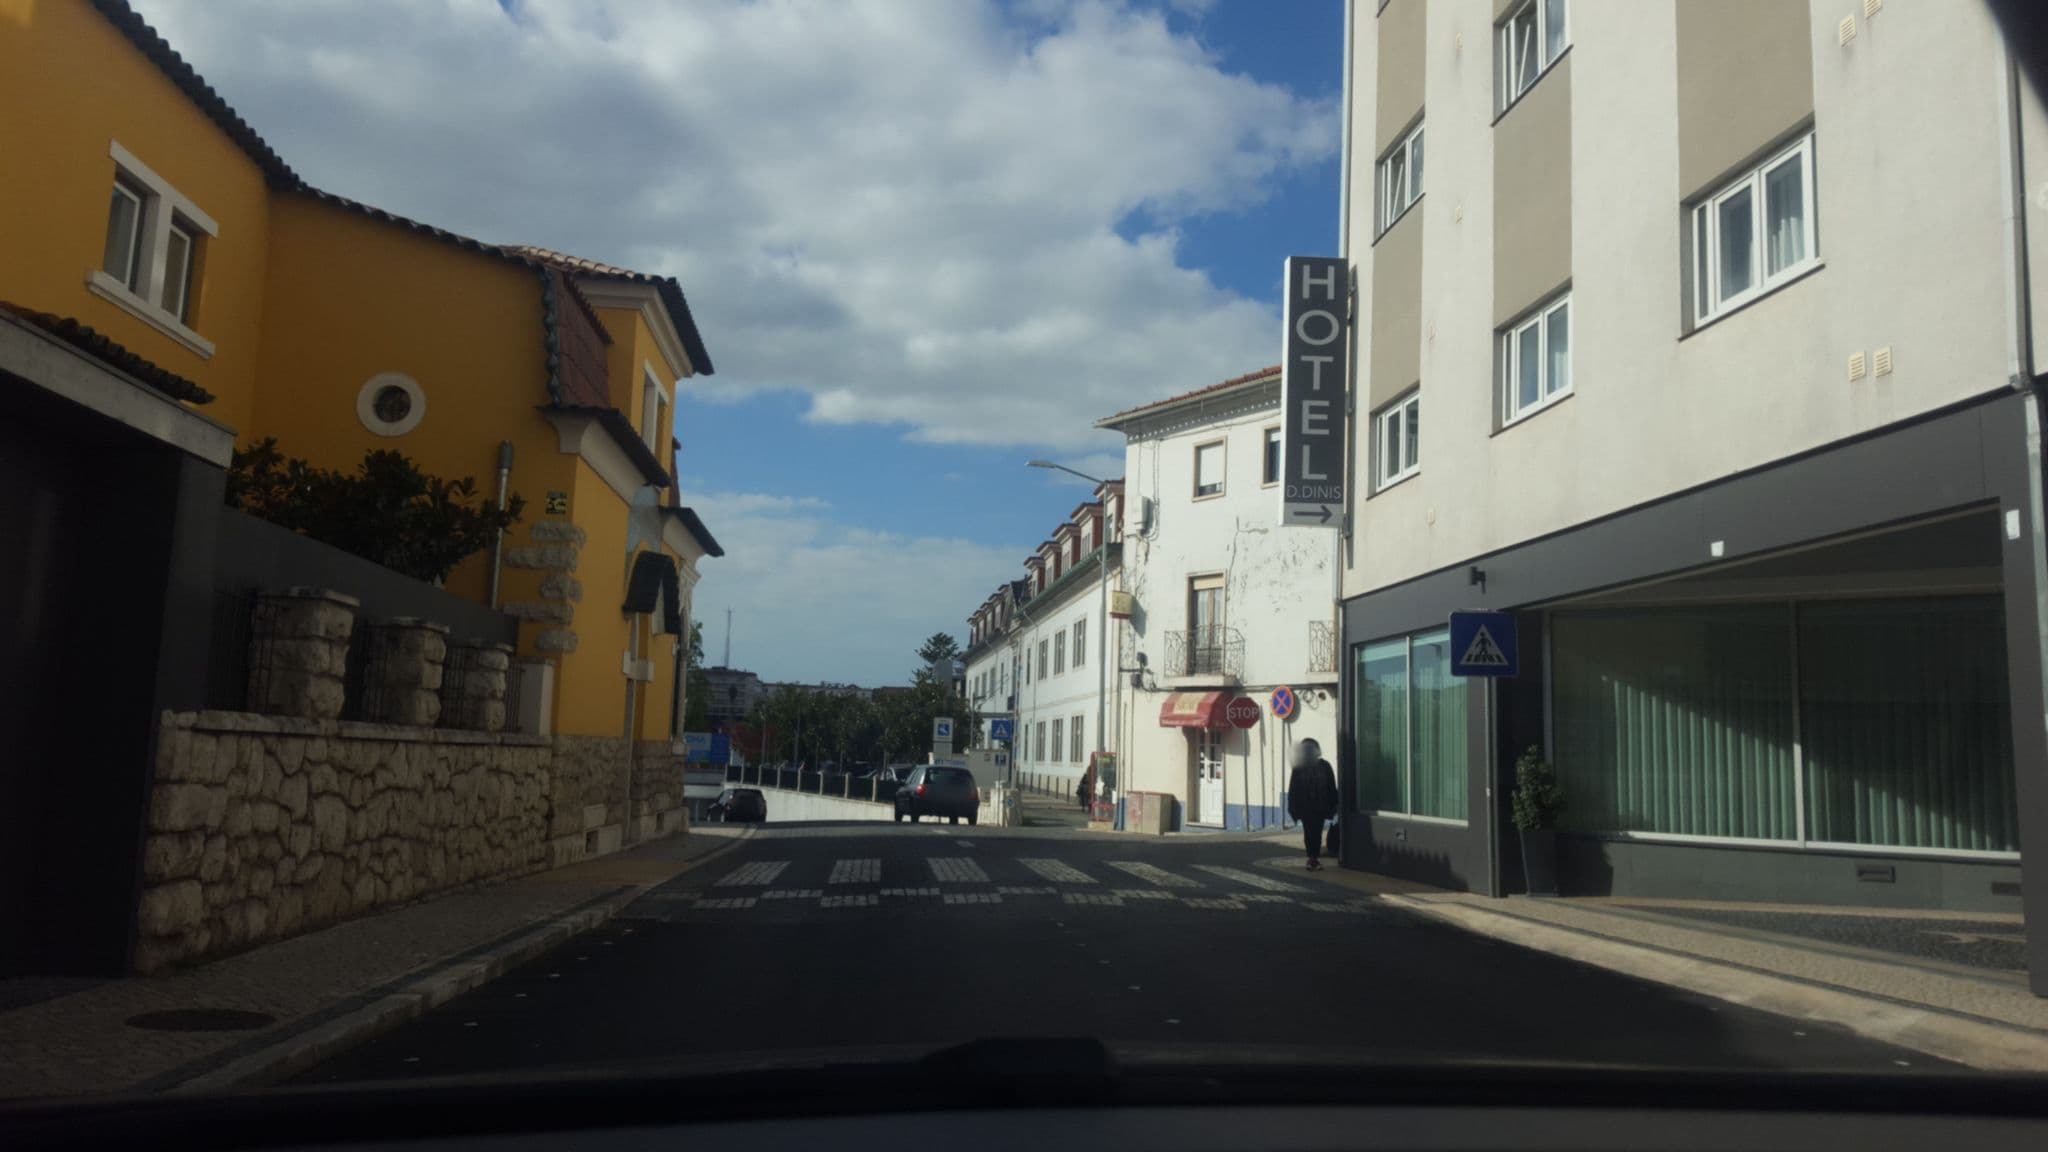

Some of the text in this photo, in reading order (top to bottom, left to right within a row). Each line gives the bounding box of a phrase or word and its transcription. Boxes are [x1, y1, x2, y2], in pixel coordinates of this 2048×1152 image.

[1295, 264, 1340, 480] HOTEL
[1286, 484, 1342, 499] D.DINIS
[1229, 707, 1259, 719] STOP
